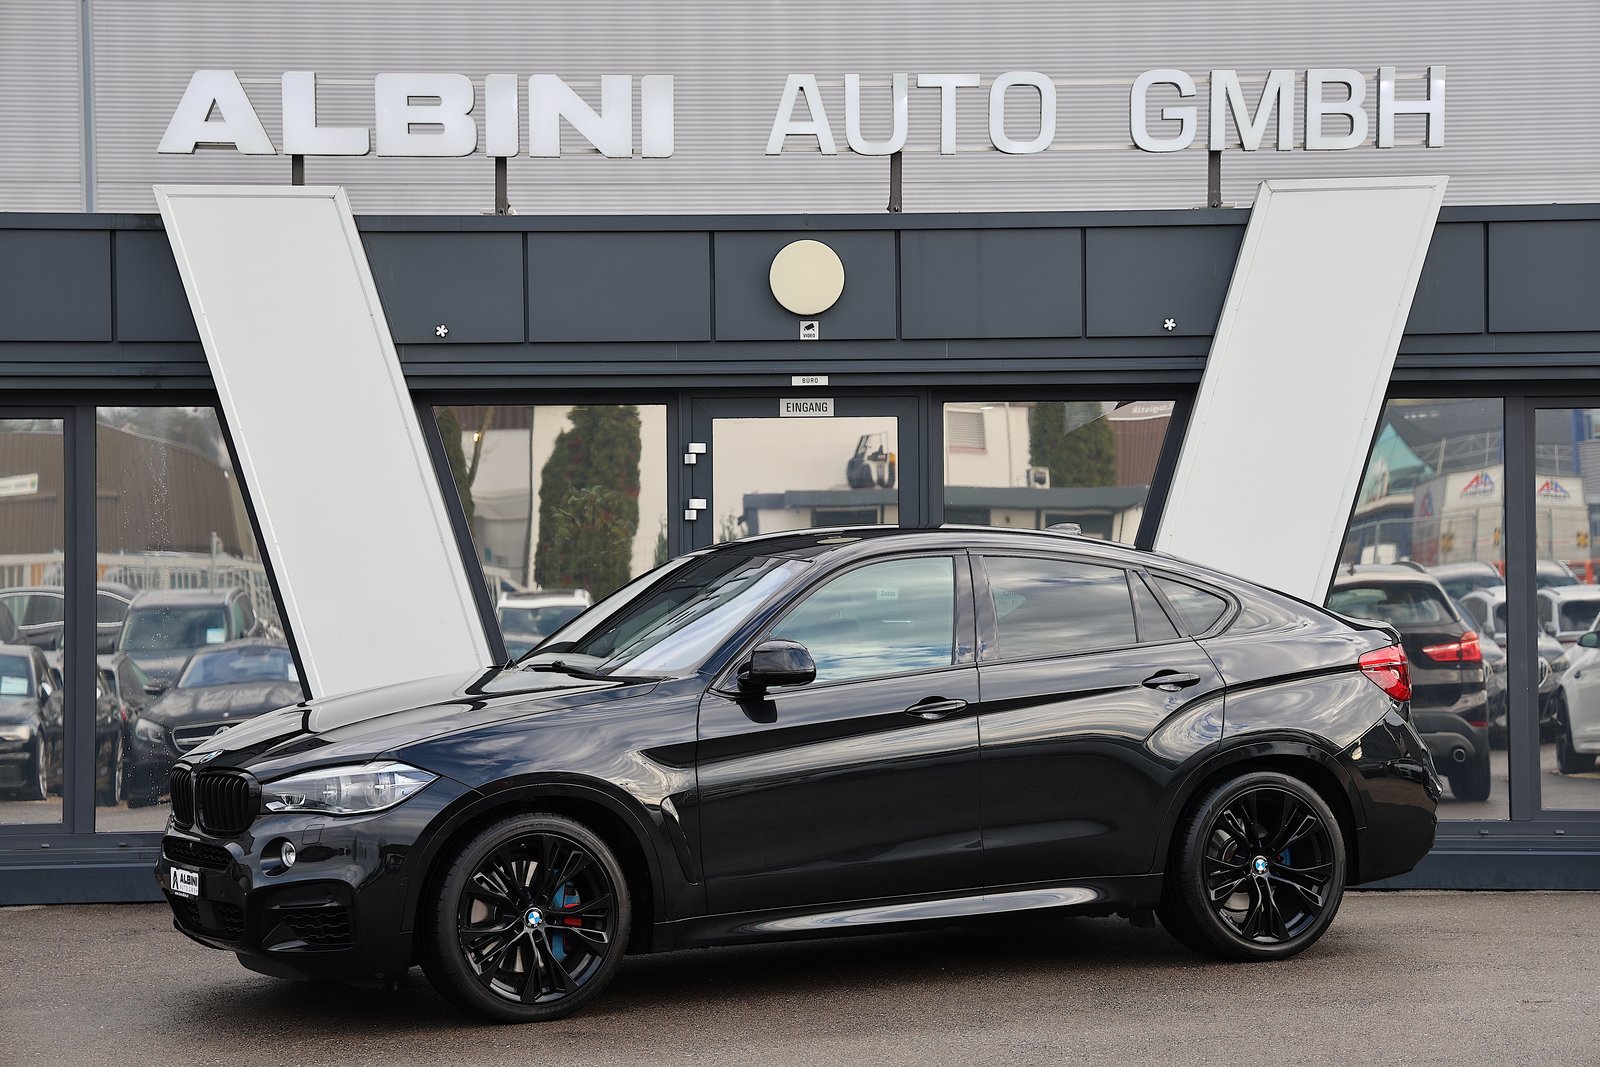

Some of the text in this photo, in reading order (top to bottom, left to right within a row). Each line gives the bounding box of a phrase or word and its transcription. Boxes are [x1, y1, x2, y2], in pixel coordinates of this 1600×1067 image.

[157, 65, 1446, 158] ALBINI AUTO GMBH
[786, 402, 828, 413] EINGANG
